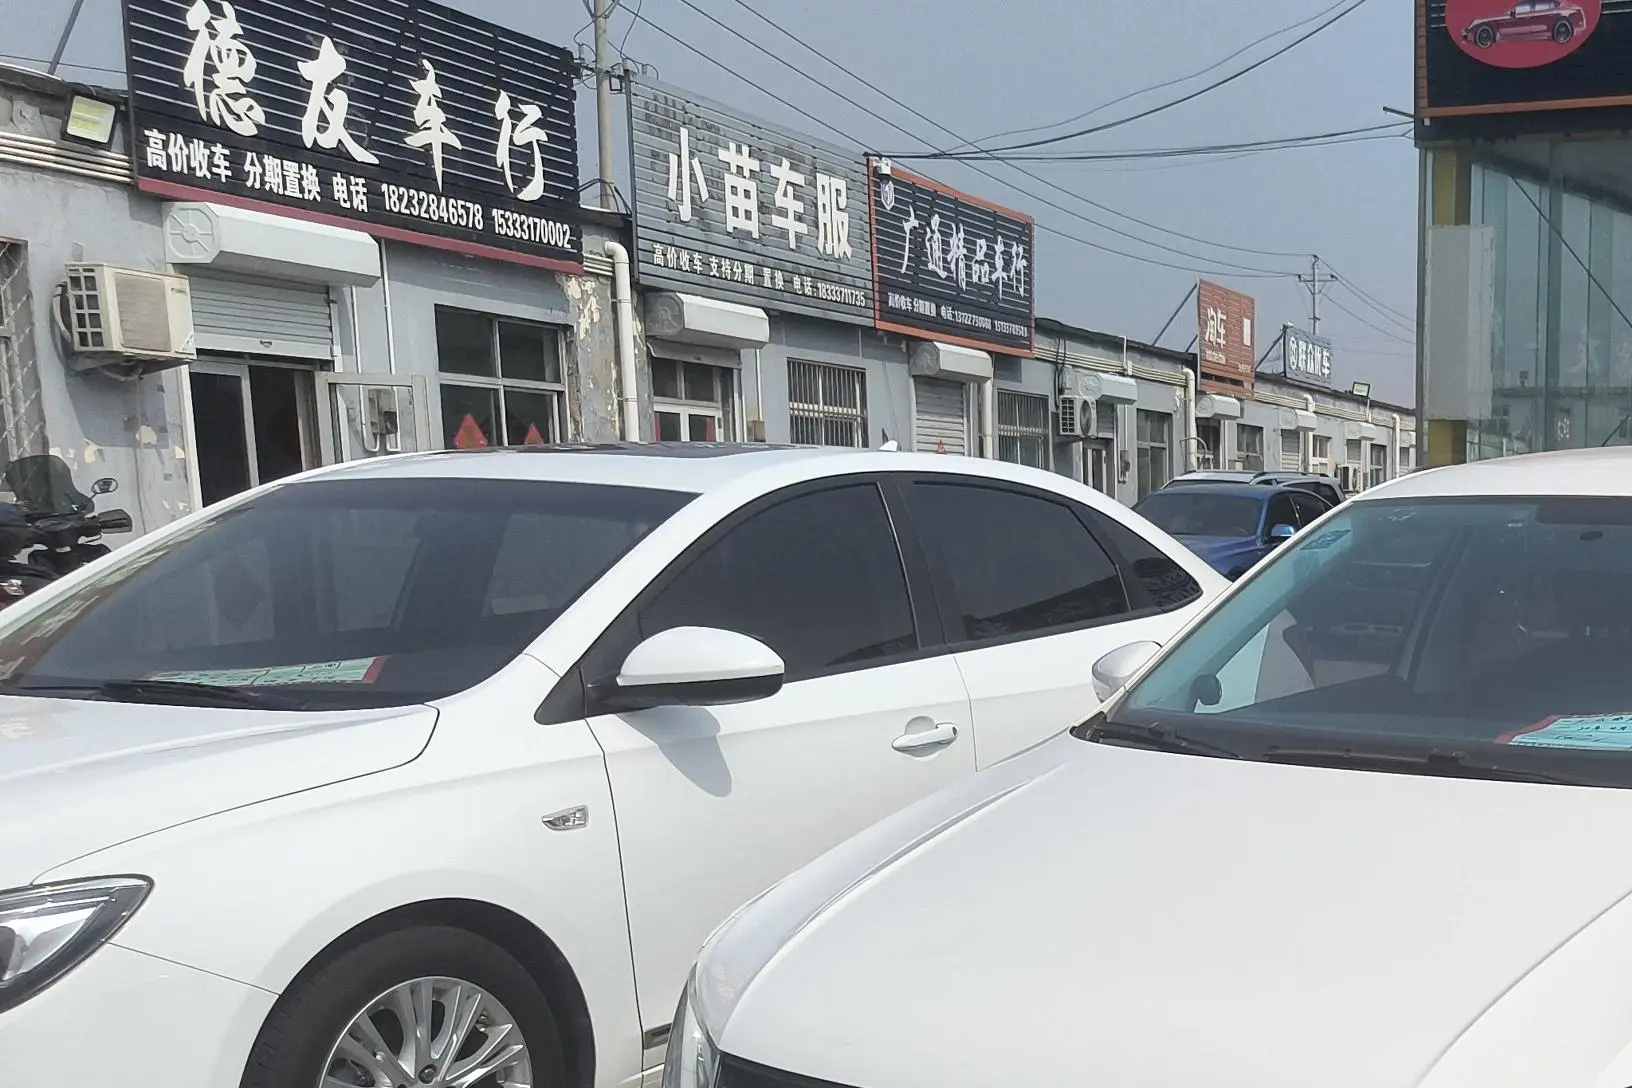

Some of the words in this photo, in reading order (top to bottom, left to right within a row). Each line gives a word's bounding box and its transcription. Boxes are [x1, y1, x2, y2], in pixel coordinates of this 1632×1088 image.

[183, 0, 549, 201] 德友车行
[143, 128, 233, 183] 高价收车
[243, 151, 322, 203] 分期置换
[332, 171, 369, 214] 电话
[381, 182, 484, 231] 18232846578
[491, 207, 572, 249] 15333170002
[667, 126, 853, 262] 小苗车服
[652, 243, 704, 275] 高价收车
[708, 255, 755, 285] 支持分期
[762, 266, 785, 291] 置换
